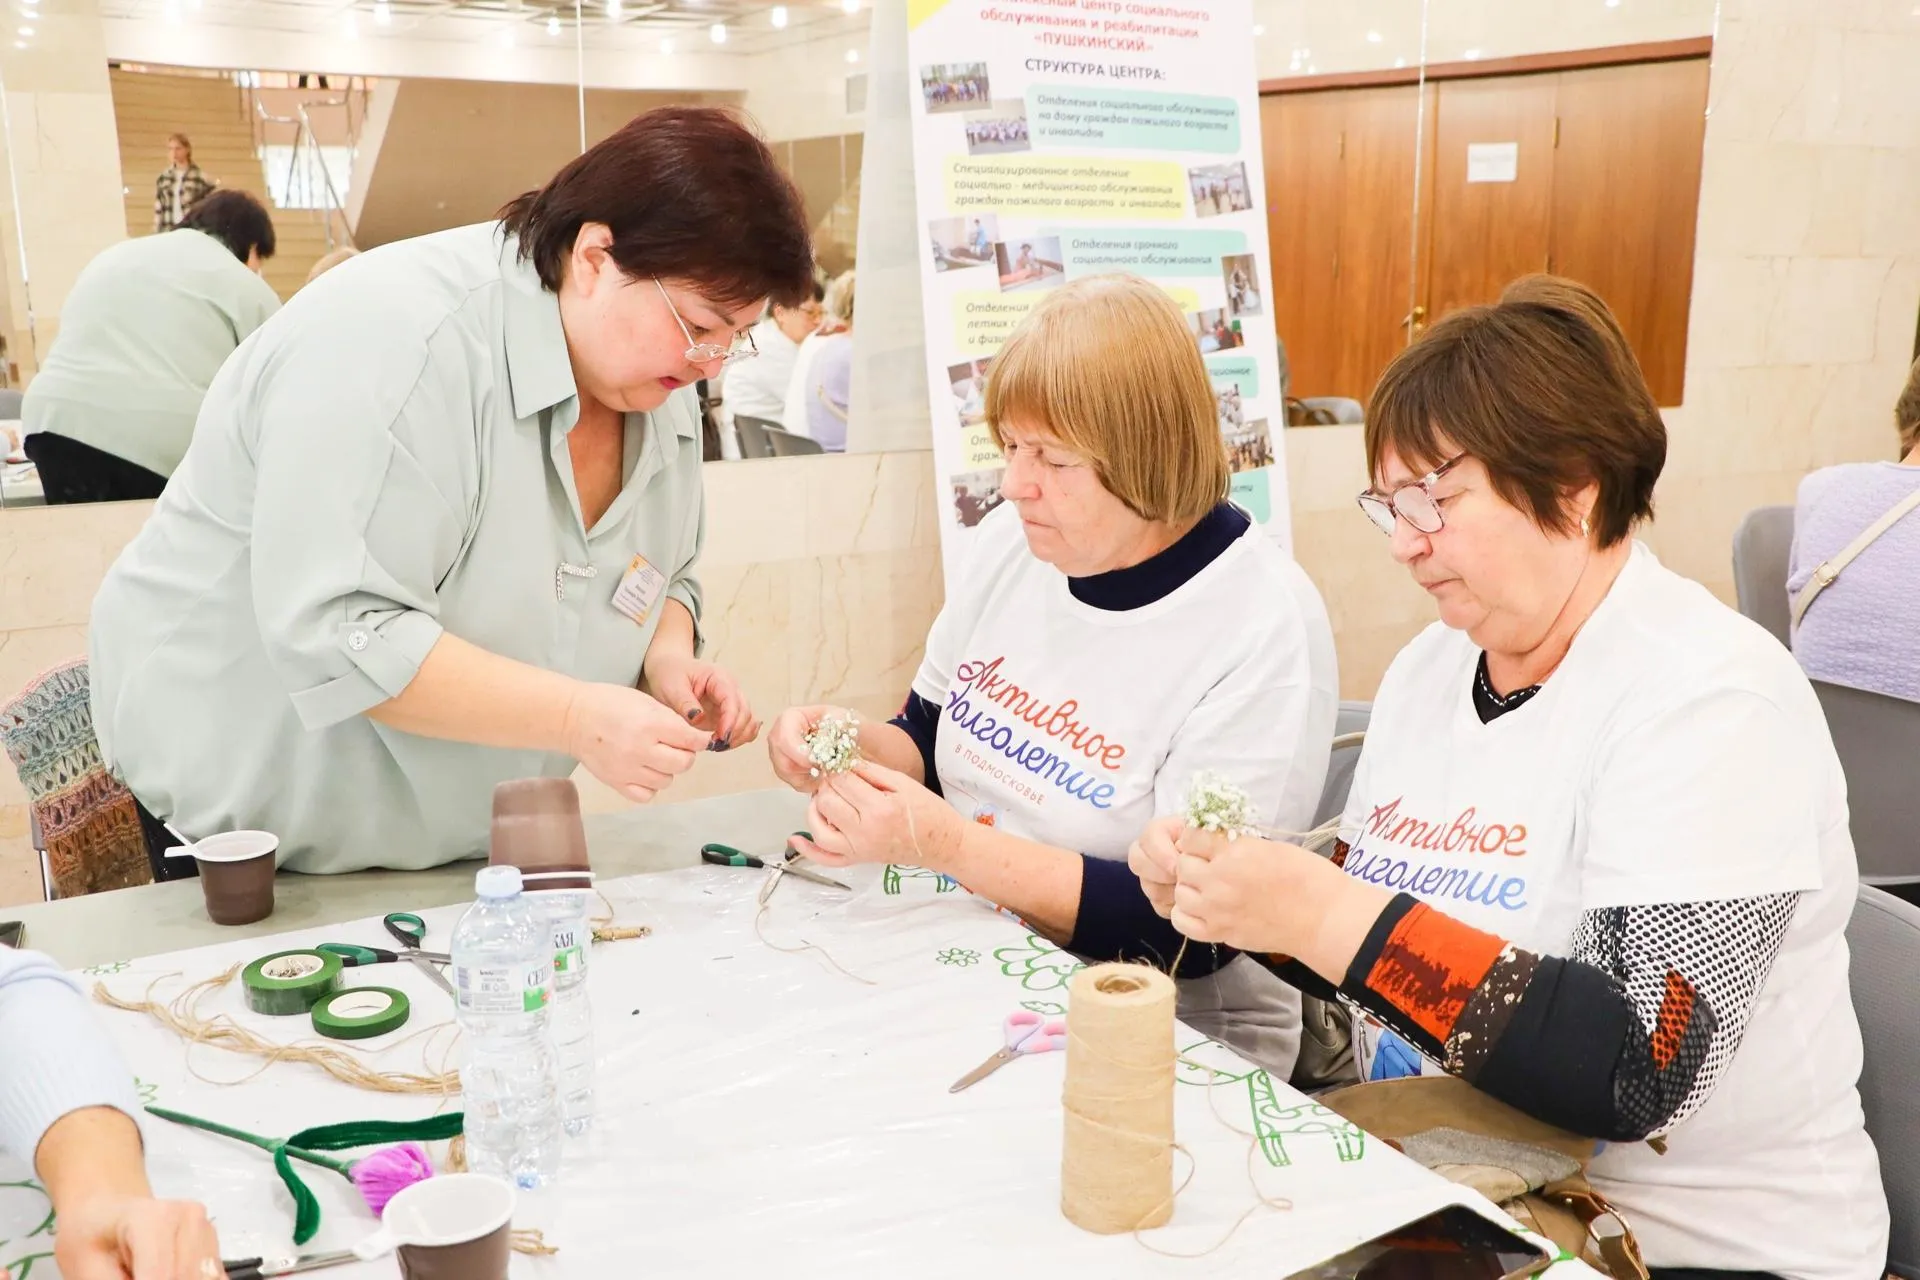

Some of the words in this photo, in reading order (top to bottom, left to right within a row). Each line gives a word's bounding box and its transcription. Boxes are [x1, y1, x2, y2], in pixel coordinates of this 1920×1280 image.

[980, 8, 1087, 27] обслуживания
[1091, 19, 1099, 28] и
[1103, 20, 1199, 38] реабилитации
[1081, 1, 1122, 14] центр
[1126, 4, 1210, 22] социального
[1034, 31, 1154, 52] «ПУШКИНСКИЙ»
[1025, 58, 1106, 76] СТРУКТУРА
[1110, 65, 1166, 81] ЦЕНТРА:
[1037, 95, 1097, 108] Отделения
[1100, 100, 1164, 112] социального
[957, 656, 1126, 770] Активное
[954, 743, 962, 754] В
[963, 749, 1047, 806] ПОДМОСКОВЬЕ
[1365, 795, 1528, 857] Активное
[1344, 832, 1528, 911] олголетие
